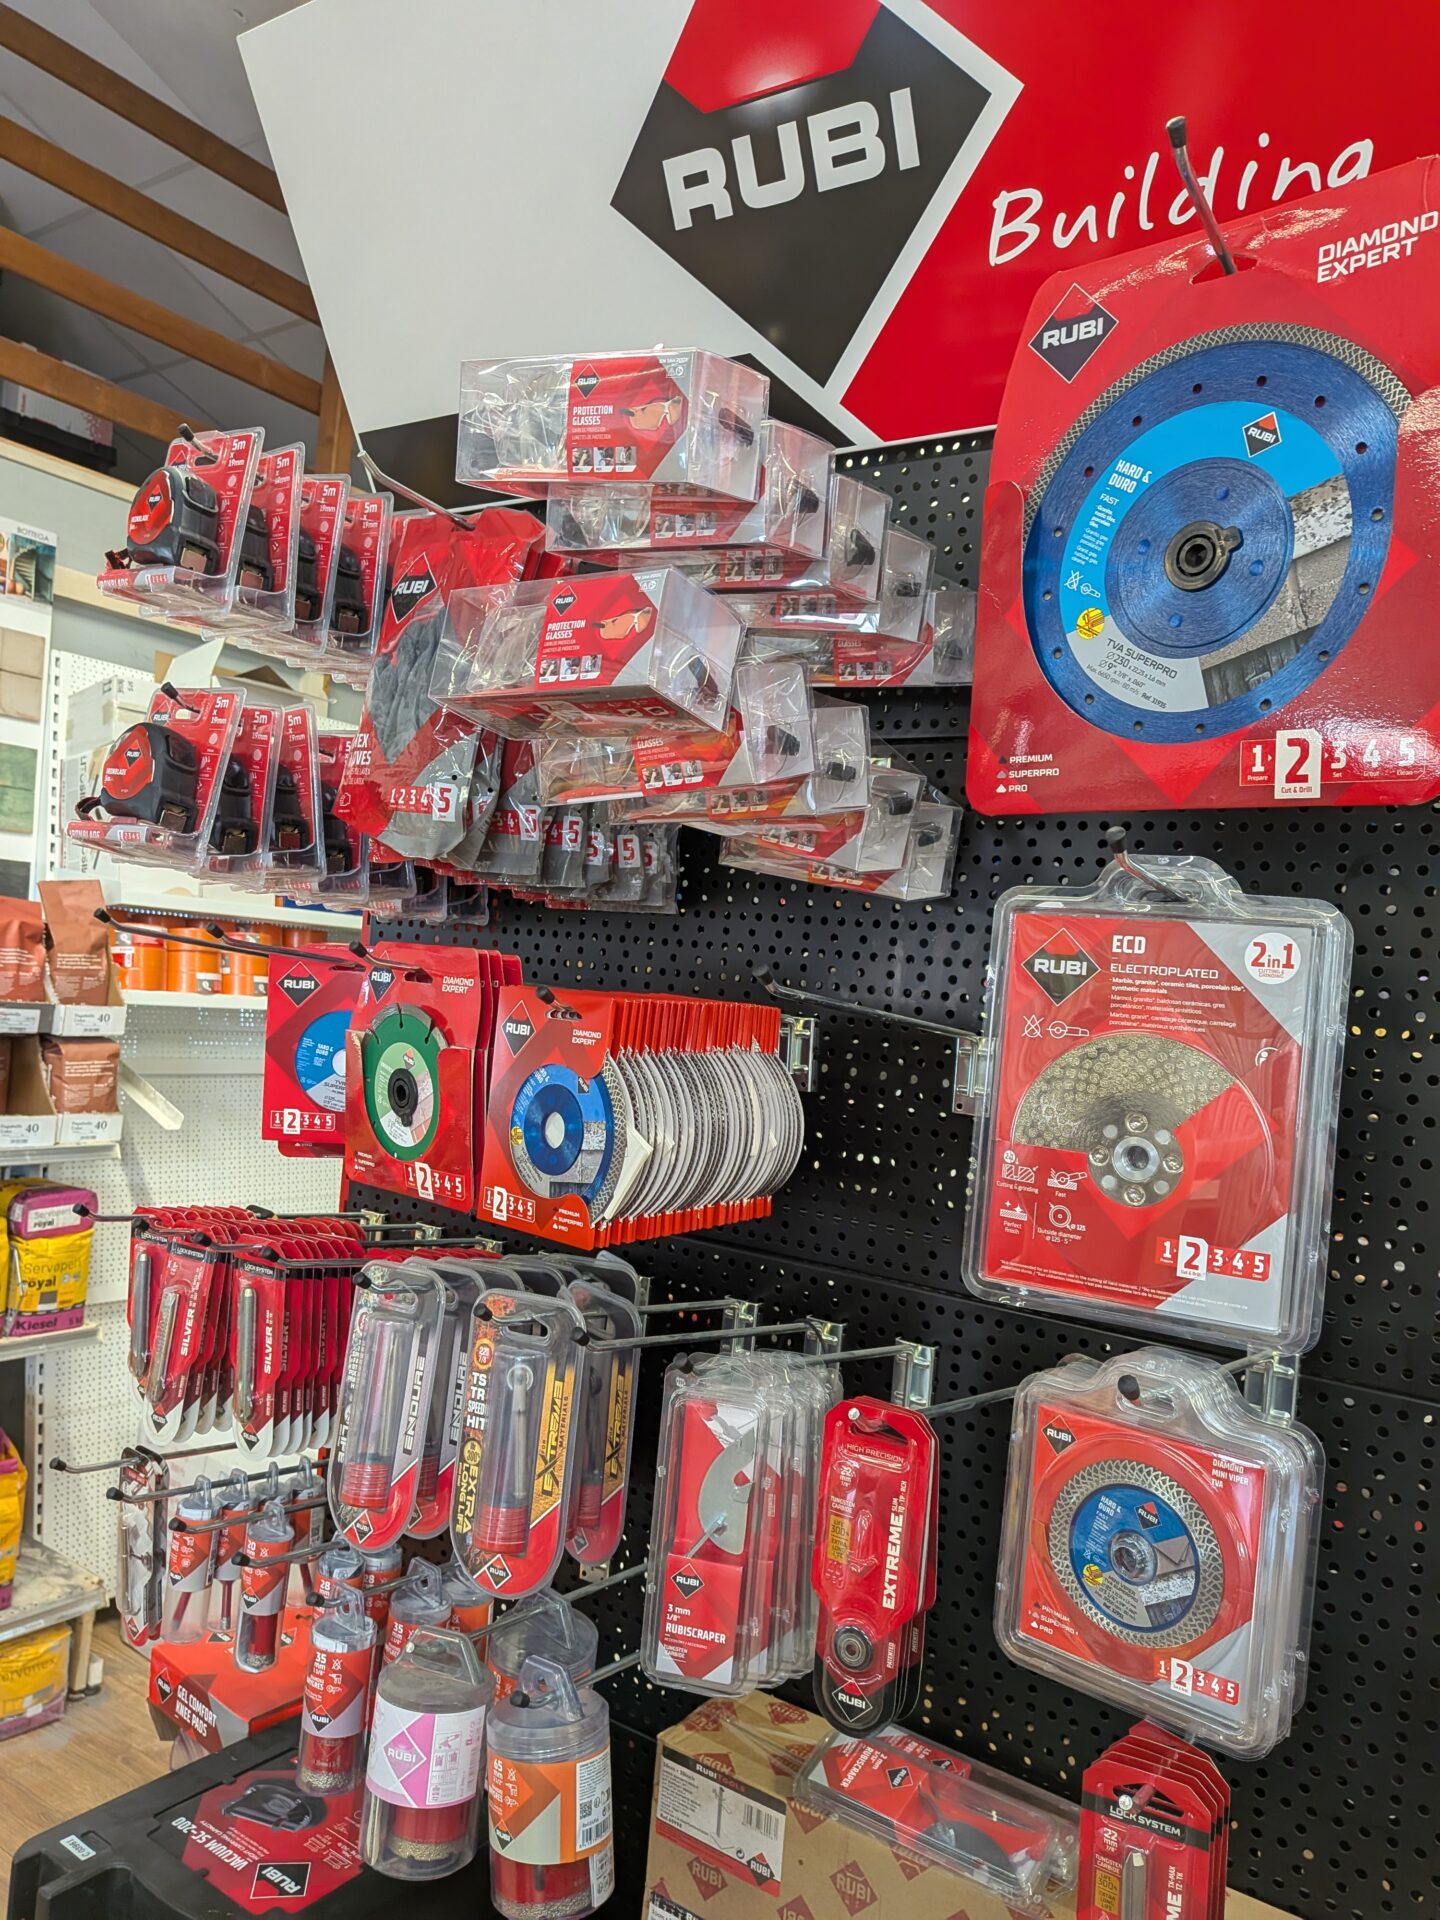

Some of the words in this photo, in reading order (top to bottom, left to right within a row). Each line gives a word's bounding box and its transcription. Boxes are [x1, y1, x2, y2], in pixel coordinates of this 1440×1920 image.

[661, 86, 921, 232] RUBI
[1318, 211, 1439, 264] DIAMOND
[1317, 236, 1419, 284] EXPERT
[1041, 315, 1107, 350] RUBI
[573, 405, 614, 415] PROTECTION
[572, 416, 600, 426] GLASSES
[232, 438, 246, 451] 5m
[227, 459, 245, 467] 19mm
[276, 456, 290, 468] 5m
[1116, 460, 1144, 480] HARD
[322, 484, 336, 496] 5m
[1108, 472, 1138, 494] DURO
[1100, 492, 1120, 506] FAST
[364, 502, 378, 513] 5m
[395, 579, 429, 595] RUBI
[555, 596, 574, 604] RUBI
[548, 620, 586, 632] PROTECTION
[545, 630, 572, 640] GLASSES
[1106, 638, 1124, 653] TVA
[1125, 648, 1178, 679] SUPERPRO
[215, 697, 229, 709] 5m
[211, 716, 227, 724] 19mm
[254, 712, 268, 724] 5m
[288, 714, 302, 726] 5m
[289, 734, 305, 742] 19mm
[637, 737, 664, 749] GLASSES
[1009, 753, 1053, 764] PREMIUM
[1251, 744, 1265, 773] 1
[1285, 737, 1310, 784] 2
[1330, 740, 1347, 770] 3
[1362, 738, 1381, 768] 4
[1397, 736, 1416, 767] 5
[1008, 768, 1060, 778] SUPERPRO
[1008, 784, 1028, 793] PRO
[390, 788, 396, 804] 1
[398, 788, 406, 804] 2
[409, 790, 416, 805] 3
[437, 786, 452, 813] 5
[568, 820, 580, 844] 5
[623, 838, 636, 861] 5
[1112, 934, 1146, 954] ECD
[1033, 957, 1087, 976] RUBI
[1110, 962, 1219, 979] ELECTROPLATED
[283, 979, 315, 990] RUBI
[370, 971, 392, 984] RUBI
[443, 976, 475, 987] DIAMOND
[441, 984, 469, 994] EXPERT
[98, 1013, 110, 1022] 40
[505, 1022, 531, 1036] RUBI
[573, 1029, 602, 1039] DIAMOND
[571, 1037, 596, 1046] EXPERT
[95, 1121, 108, 1130] 40
[287, 1112, 296, 1129] 2
[25, 1124, 39, 1133] 40
[420, 1167, 429, 1192] 2
[433, 1173, 440, 1188] 3
[444, 1175, 451, 1190] 4
[455, 1177, 462, 1193] 5
[496, 1190, 504, 1214] 2
[527, 1202, 532, 1216] 5
[558, 1208, 580, 1217] PREMIUM
[34, 1219, 54, 1228] royal
[558, 1217, 584, 1227] SUPERPRO
[1058, 1231, 1082, 1240] diameter
[1162, 1241, 1173, 1258] 1
[1183, 1241, 1201, 1271] 2
[1211, 1249, 1224, 1266] 3
[1231, 1251, 1244, 1270] 4
[1253, 1256, 1265, 1273] 5
[23, 1259, 82, 1274] Servopen
[256, 1266, 274, 1276] SYSTEM
[22, 1276, 56, 1291] royal
[16, 1318, 58, 1331] Kiesel
[180, 1307, 196, 1357] SILVER
[264, 1326, 273, 1375] SILVER
[472, 1373, 487, 1385] TS
[470, 1387, 485, 1400] TR
[403, 1356, 426, 1450] ENDURE
[559, 1396, 569, 1448] MATERIALS
[537, 1380, 564, 1493] EXTREME
[1046, 1428, 1072, 1443] RUBI
[846, 1444, 864, 1454] HIGH
[865, 1448, 904, 1464] PRECISION
[1212, 1458, 1244, 1474] DIAMOND
[459, 1463, 470, 1502] LONG
[1212, 1468, 1227, 1480] MINI
[1228, 1472, 1249, 1486] VIPER
[463, 1465, 479, 1534] EXTRA
[831, 1495, 855, 1508] TUNGSTEN
[1101, 1496, 1117, 1510] HARD
[832, 1502, 853, 1513] CARBIDE
[1098, 1502, 1115, 1516] DURO
[455, 1504, 464, 1534] LIFE
[1137, 1508, 1159, 1525] RUBI
[882, 1512, 904, 1610] EXTREME
[489, 1567, 506, 1578] RUBI
[320, 1580, 331, 1590] 28
[676, 1576, 700, 1587] RUBI
[668, 1604, 673, 1612] 3
[675, 1607, 691, 1616] mm
[666, 1613, 681, 1622] 1/8"
[393, 1622, 404, 1634] 35
[665, 1622, 726, 1644] RUBISCRAPER
[1039, 1624, 1053, 1635] PRO
[316, 1652, 327, 1664] 35
[887, 1641, 895, 1670] PATENTED
[314, 1662, 326, 1671] mm
[1159, 1660, 1166, 1674] 1
[1175, 1663, 1188, 1686] 2
[1197, 1672, 1204, 1686] 3
[1211, 1678, 1220, 1692] 4
[1227, 1683, 1235, 1698] 5
[177, 1685, 189, 1700] GEL
[189, 1693, 217, 1728] COMFORT
[838, 1692, 866, 1709] RUBI
[176, 1700, 190, 1723] KNEE
[191, 1713, 208, 1738] PADS
[312, 1714, 330, 1724] RUBI
[388, 1748, 416, 1763] RUBI
[494, 1758, 503, 1772] 65
[840, 1746, 873, 1788] RUBISCRAPER
[695, 1763, 717, 1779] RUBI
[717, 1774, 746, 1793] TOOLS
[892, 1769, 907, 1786] RUBI
[1109, 1805, 1137, 1822] LOCK
[1138, 1815, 1181, 1837] SYSTEM
[171, 1816, 212, 1844] SC-200
[1103, 1828, 1118, 1840] 22
[1103, 1838, 1118, 1848] mm
[204, 1840, 250, 1872] VACUUM
[1095, 1853, 1123, 1869] TUNGSTEN
[692, 1861, 722, 1888] RUBI
[750, 1861, 770, 1877] RUBI
[1096, 1861, 1121, 1874] CARBIDE
[261, 1866, 301, 1894] RUBI
[837, 1873, 871, 1902] RUBI
